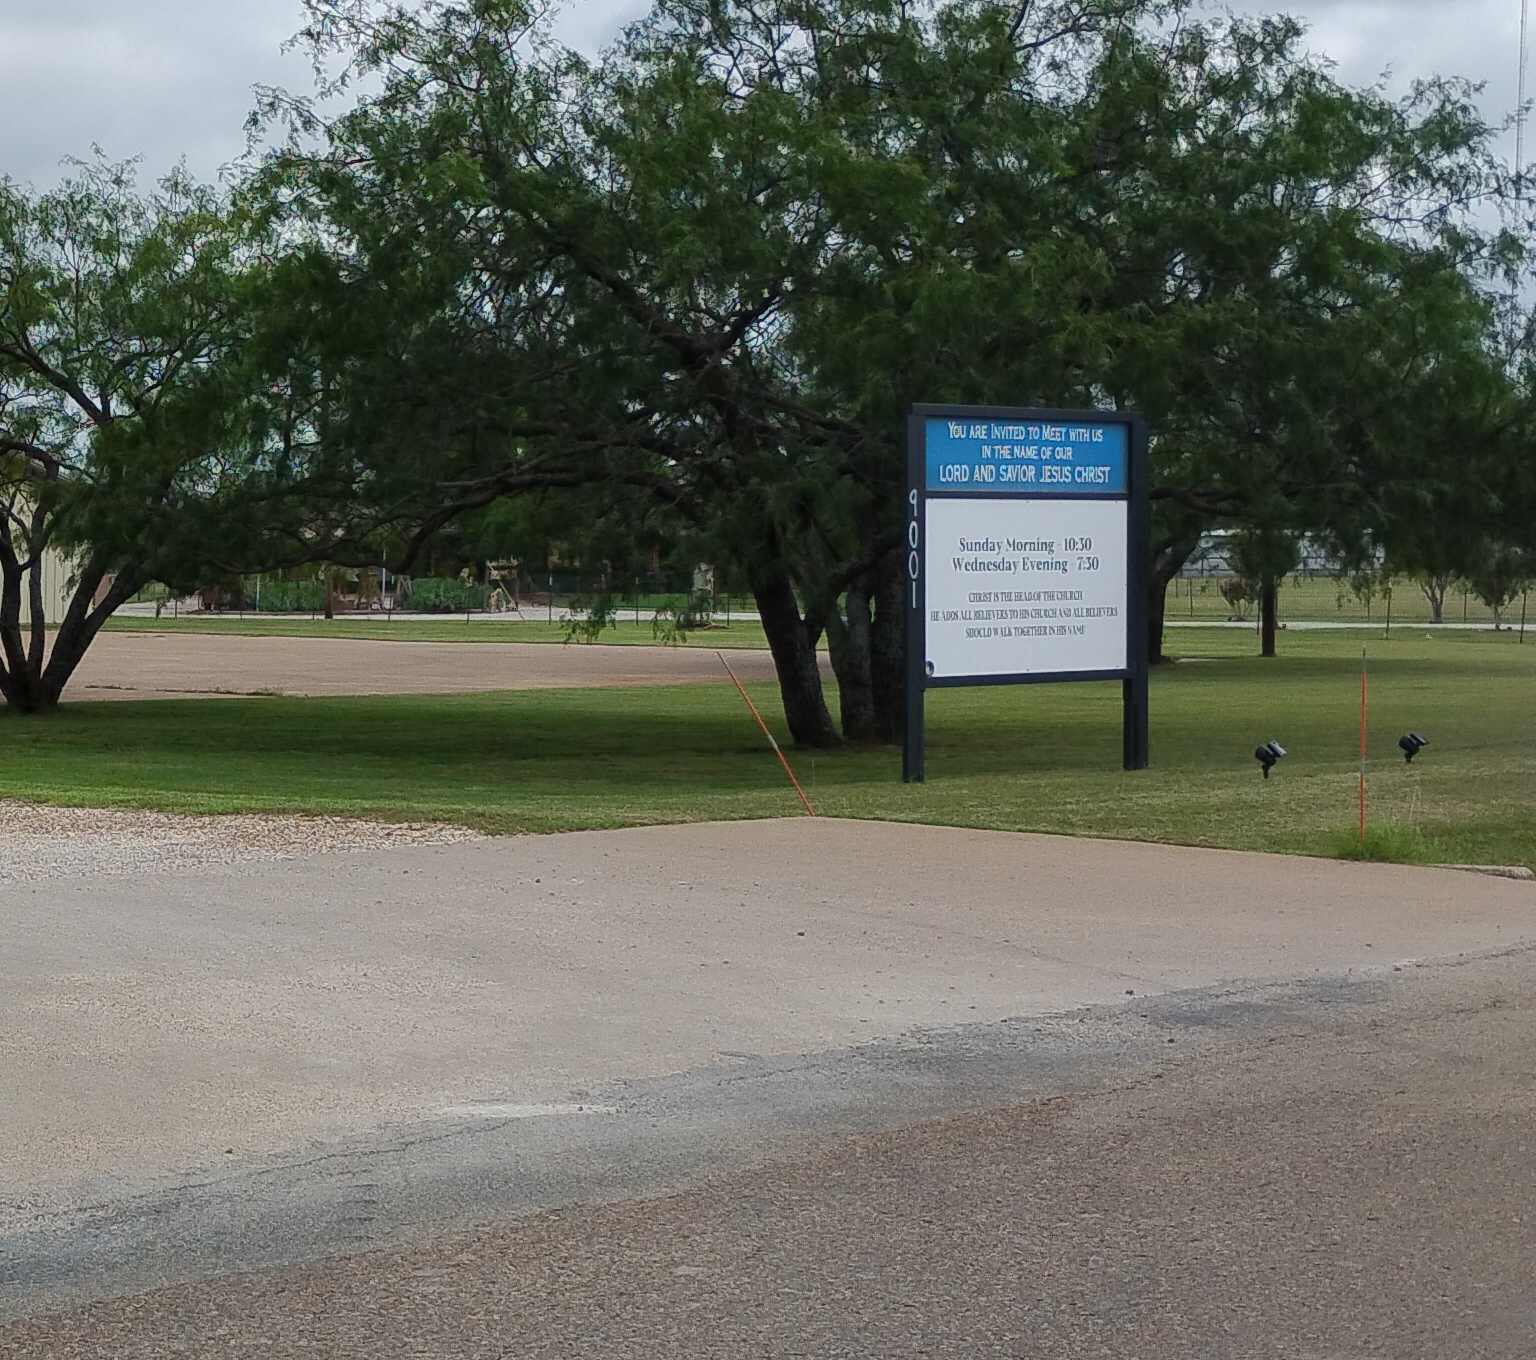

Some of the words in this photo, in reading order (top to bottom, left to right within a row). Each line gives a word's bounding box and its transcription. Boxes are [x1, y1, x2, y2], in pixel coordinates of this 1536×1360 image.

[969, 425, 988, 439] ARE
[991, 424, 1025, 440] INVITED
[1027, 426, 1040, 440] TO
[1042, 425, 1067, 441] MEET
[1069, 428, 1090, 442] WITH
[1092, 429, 1104, 442] US
[981, 445, 991, 458] IN
[993, 445, 1013, 459] THE
[1014, 445, 1039, 459] NAME
[1041, 446, 1054, 460] OF
[1055, 446, 1072, 460] OUR
[939, 464, 969, 482] LORD
[973, 464, 996, 482] AND
[999, 464, 1036, 482] SAVIOR
[1039, 465, 1072, 483] JESUS
[1075, 466, 1111, 483] CHRIST
[908, 488, 919, 609] 9001
[959, 537, 1002, 555] Sunday
[1006, 537, 1055, 555] Morning
[1064, 537, 1092, 552] 10:30
[952, 556, 1019, 574] Wednesday
[1022, 556, 1068, 574] Evening
[1077, 556, 1099, 571] 7:30
[1041, 590, 1056, 601] THE
[1056, 590, 1083, 601] CHURCH
